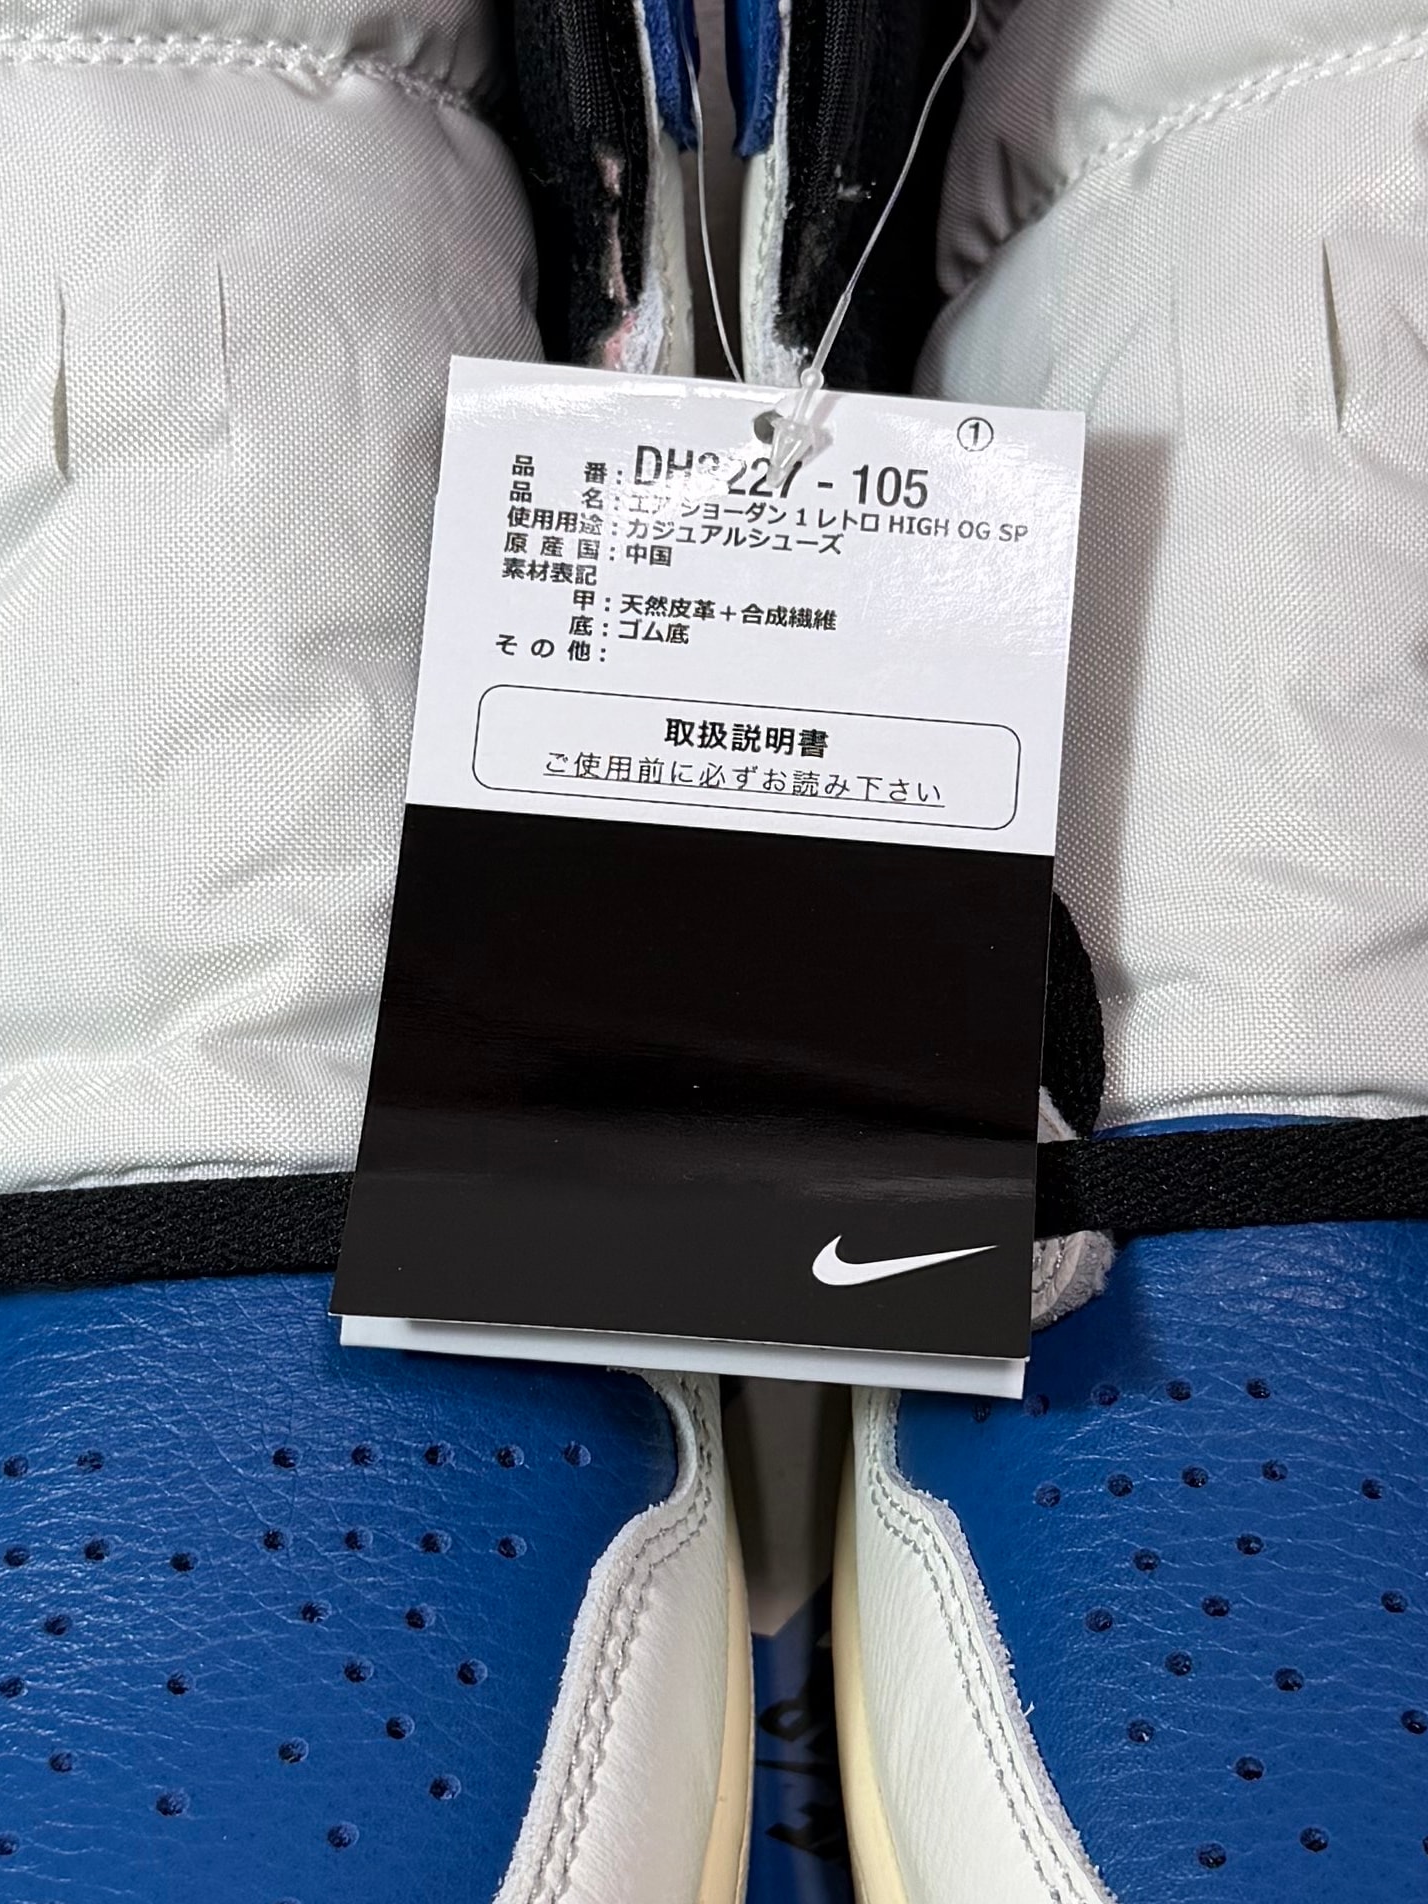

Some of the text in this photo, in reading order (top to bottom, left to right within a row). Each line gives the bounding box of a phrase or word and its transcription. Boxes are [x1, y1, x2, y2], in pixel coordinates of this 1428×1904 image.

[852, 463, 929, 510] 105
[888, 514, 949, 538] HIGH
[958, 520, 991, 541] OG
[999, 523, 1029, 544] SP
[626, 544, 672, 567] 中国
[502, 557, 598, 586] 素材表記
[618, 618, 690, 645] ゴム底
[664, 717, 830, 759] 取扱説明書
[544, 750, 944, 806] ご使用前に必ずお読み下さい
